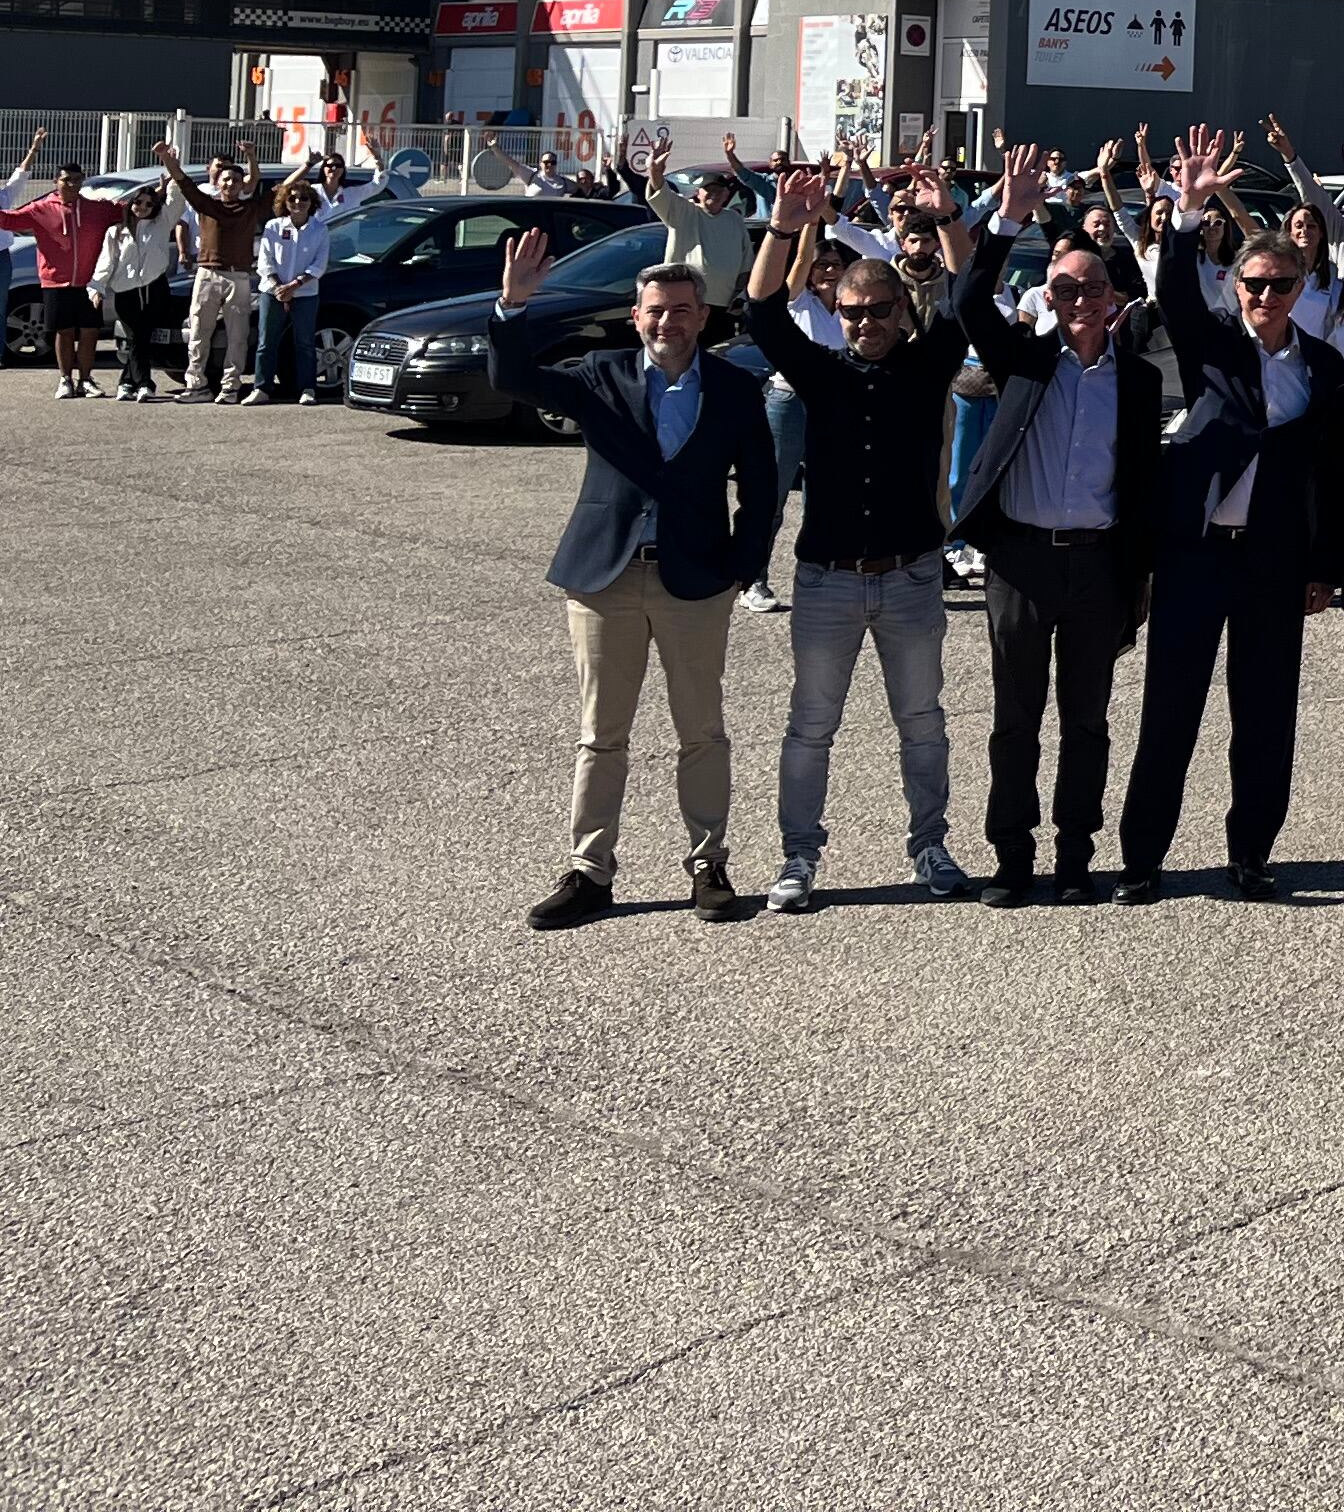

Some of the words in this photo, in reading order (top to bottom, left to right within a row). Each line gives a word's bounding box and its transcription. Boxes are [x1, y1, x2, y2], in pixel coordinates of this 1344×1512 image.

[461, 6, 499, 31] aprilia
[560, 3, 600, 29] aprilia
[1043, 7, 1116, 35] ASEOS
[685, 46, 733, 61] VALENCIA
[1038, 37, 1070, 50] BANYS
[1034, 51, 1065, 64] TOILET
[554, 108, 596, 163] 48
